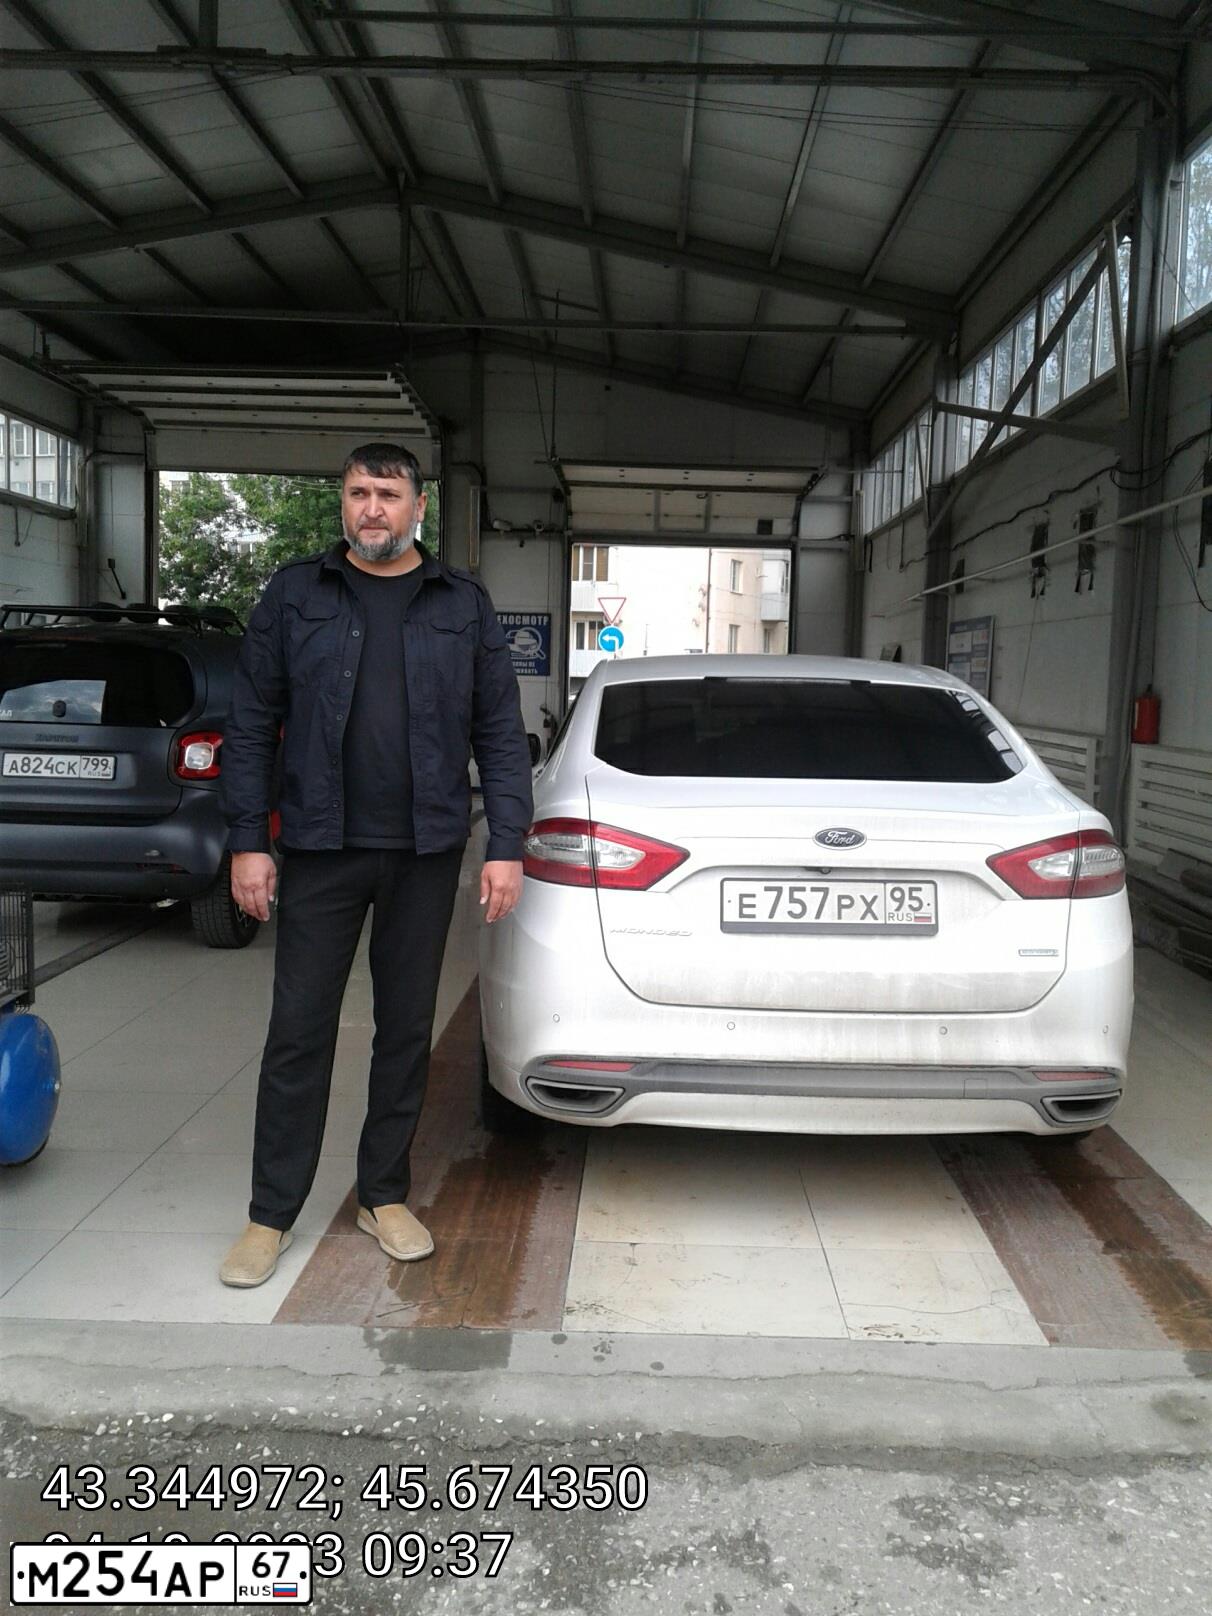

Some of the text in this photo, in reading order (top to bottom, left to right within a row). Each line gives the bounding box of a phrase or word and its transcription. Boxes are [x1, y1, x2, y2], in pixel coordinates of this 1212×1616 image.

[496, 614, 549, 626] ЕХОСМОТР
[8, 756, 109, 775] А824СК 799
[824, 830, 855, 845] Ford
[738, 886, 923, 920] Е757РХ 95
[887, 912, 913, 922] RUS
